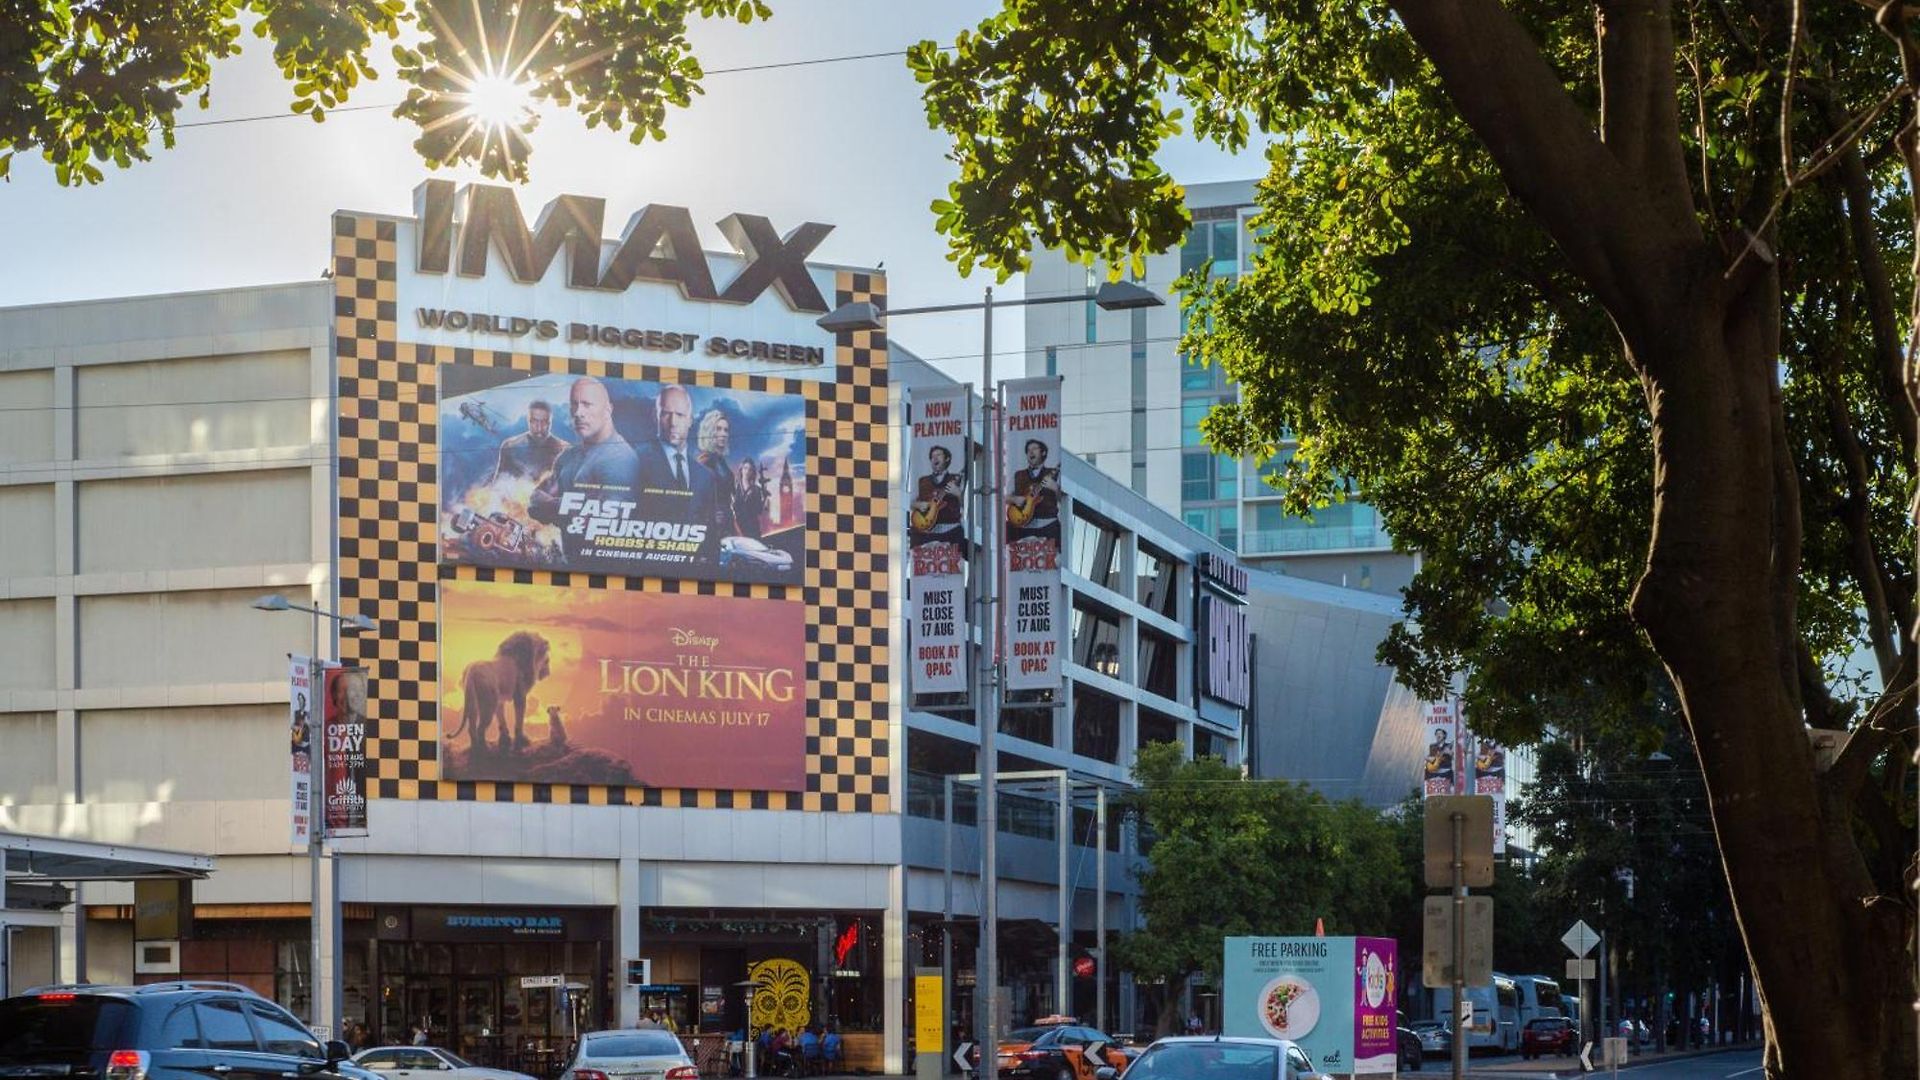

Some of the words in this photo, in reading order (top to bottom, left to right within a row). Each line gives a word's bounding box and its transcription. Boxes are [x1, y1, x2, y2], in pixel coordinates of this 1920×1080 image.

[413, 179, 837, 314] IMAX
[416, 307, 559, 338] WORLD'S
[566, 322, 699, 354] BIGGEST
[705, 336, 825, 366] SCREEN
[925, 401, 952, 418] NOW
[1020, 394, 1047, 412] NOW
[914, 420, 962, 438] PLAYING
[1009, 413, 1058, 431] PLAYING
[558, 492, 637, 519] FAST
[594, 535, 644, 550] HOBBS
[645, 537, 656, 550] &
[657, 540, 700, 553] SHAW
[580, 548, 592, 557] IN
[595, 549, 643, 561] CINEMAS
[645, 551, 686, 562] AUGUST
[1010, 551, 1057, 572] ROCK
[913, 557, 962, 576] ROCK
[923, 590, 953, 605] MUST
[1019, 586, 1049, 601] MUST
[922, 606, 954, 621] CLOSE
[1018, 602, 1050, 617] CLOSE
[921, 623, 932, 637] 17
[934, 622, 954, 636] AUG
[1017, 619, 1027, 633] 17
[1030, 618, 1050, 632] AUG
[669, 627, 719, 650] Disney
[918, 646, 946, 661] BOOK
[949, 645, 960, 659] AT
[1014, 642, 1041, 657] BOOK
[1044, 641, 1056, 655] AT
[676, 654, 710, 668] THE
[1021, 659, 1047, 675] QPAC
[925, 663, 952, 679] QPAC
[598, 659, 691, 698] LION
[697, 668, 796, 702] KING
[624, 707, 641, 720] IN
[646, 708, 716, 724] CINEMAS
[721, 711, 752, 728] JULY
[757, 712, 771, 726] 17
[328, 724, 364, 736] OPEN
[328, 735, 364, 752] DAY
[328, 795, 364, 805] Griffith
[447, 915, 523, 927] BURRITO
[526, 916, 562, 927] BAR
[1251, 943, 1277, 958] FREE
[1280, 943, 1327, 958] PARKING
[1363, 1014, 1374, 1026] FREE
[1375, 1014, 1388, 1026] KIDS
[1361, 1028, 1390, 1040] ACTIVITIES
